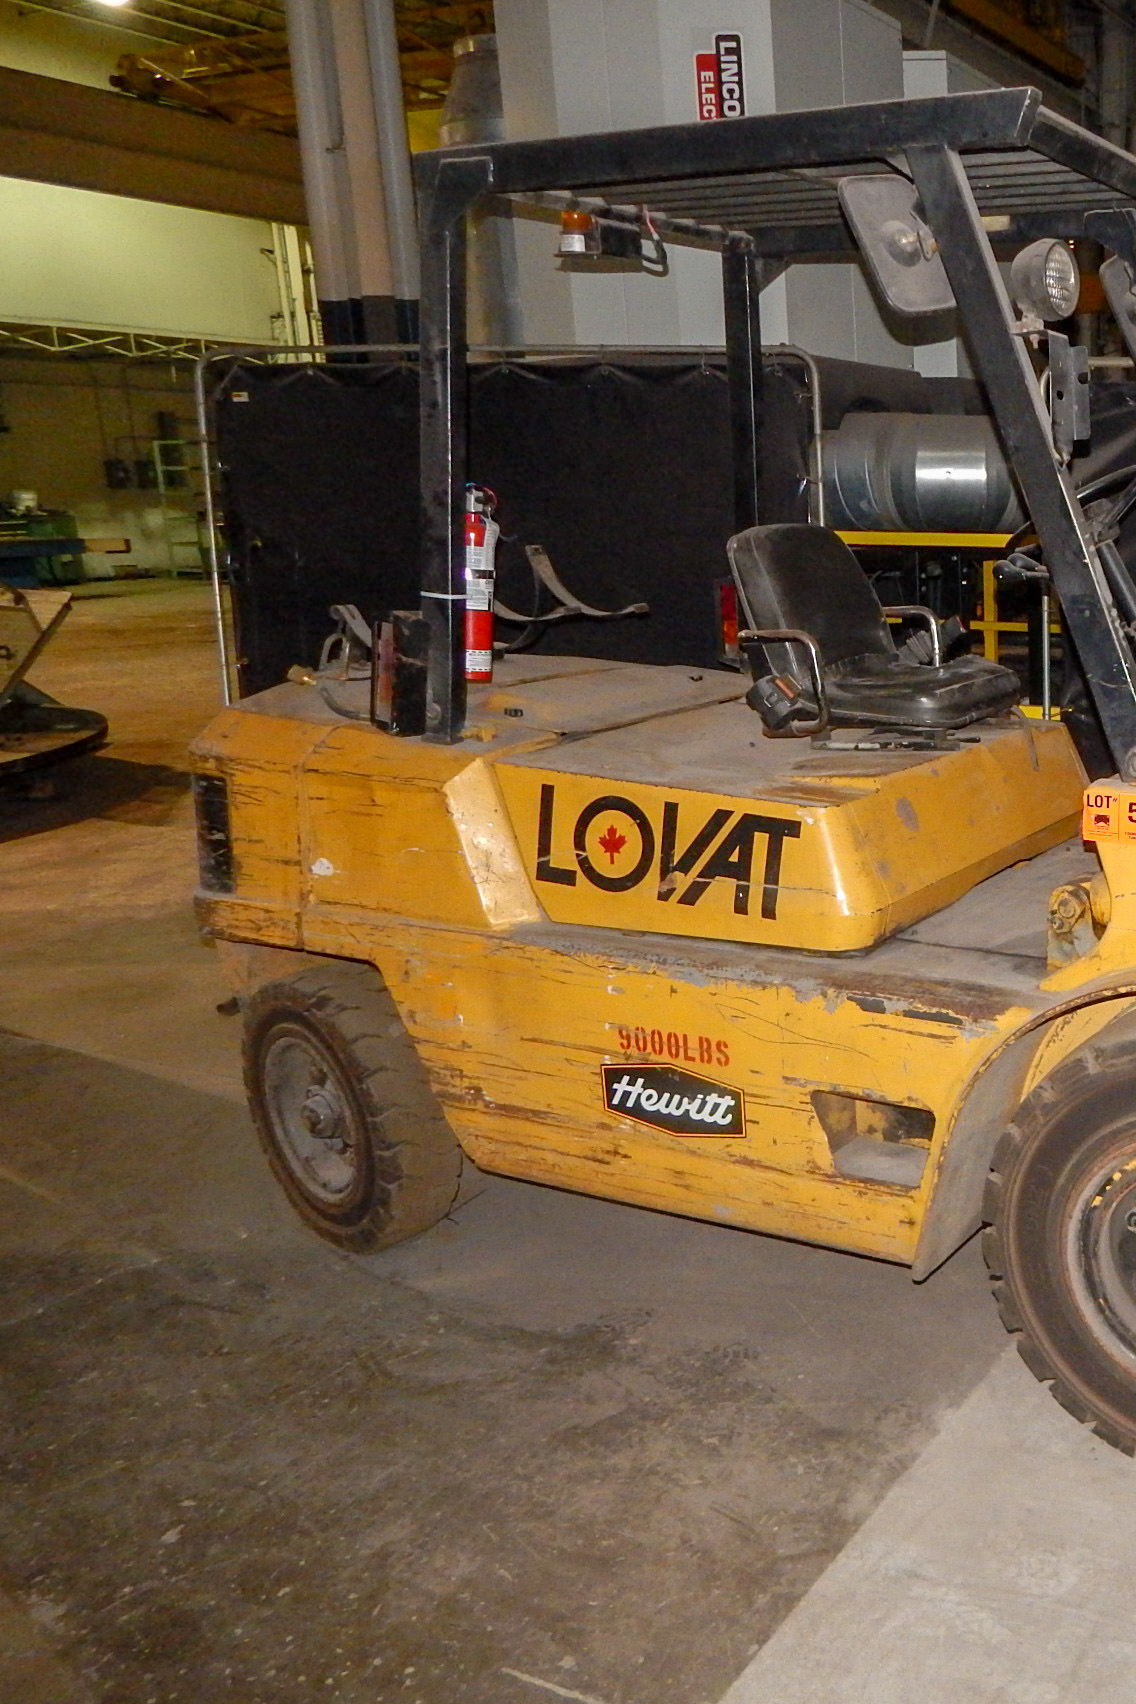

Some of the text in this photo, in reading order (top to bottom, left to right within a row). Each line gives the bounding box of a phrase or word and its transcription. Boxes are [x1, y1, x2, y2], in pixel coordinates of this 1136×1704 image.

[700, 71, 717, 118] ELEC
[719, 41, 741, 117] LINCO
[1086, 794, 1112, 808] LOT
[535, 783, 802, 921] LOVAT
[617, 1026, 730, 1067] 9000LBS
[611, 1075, 736, 1126] Hewitt
